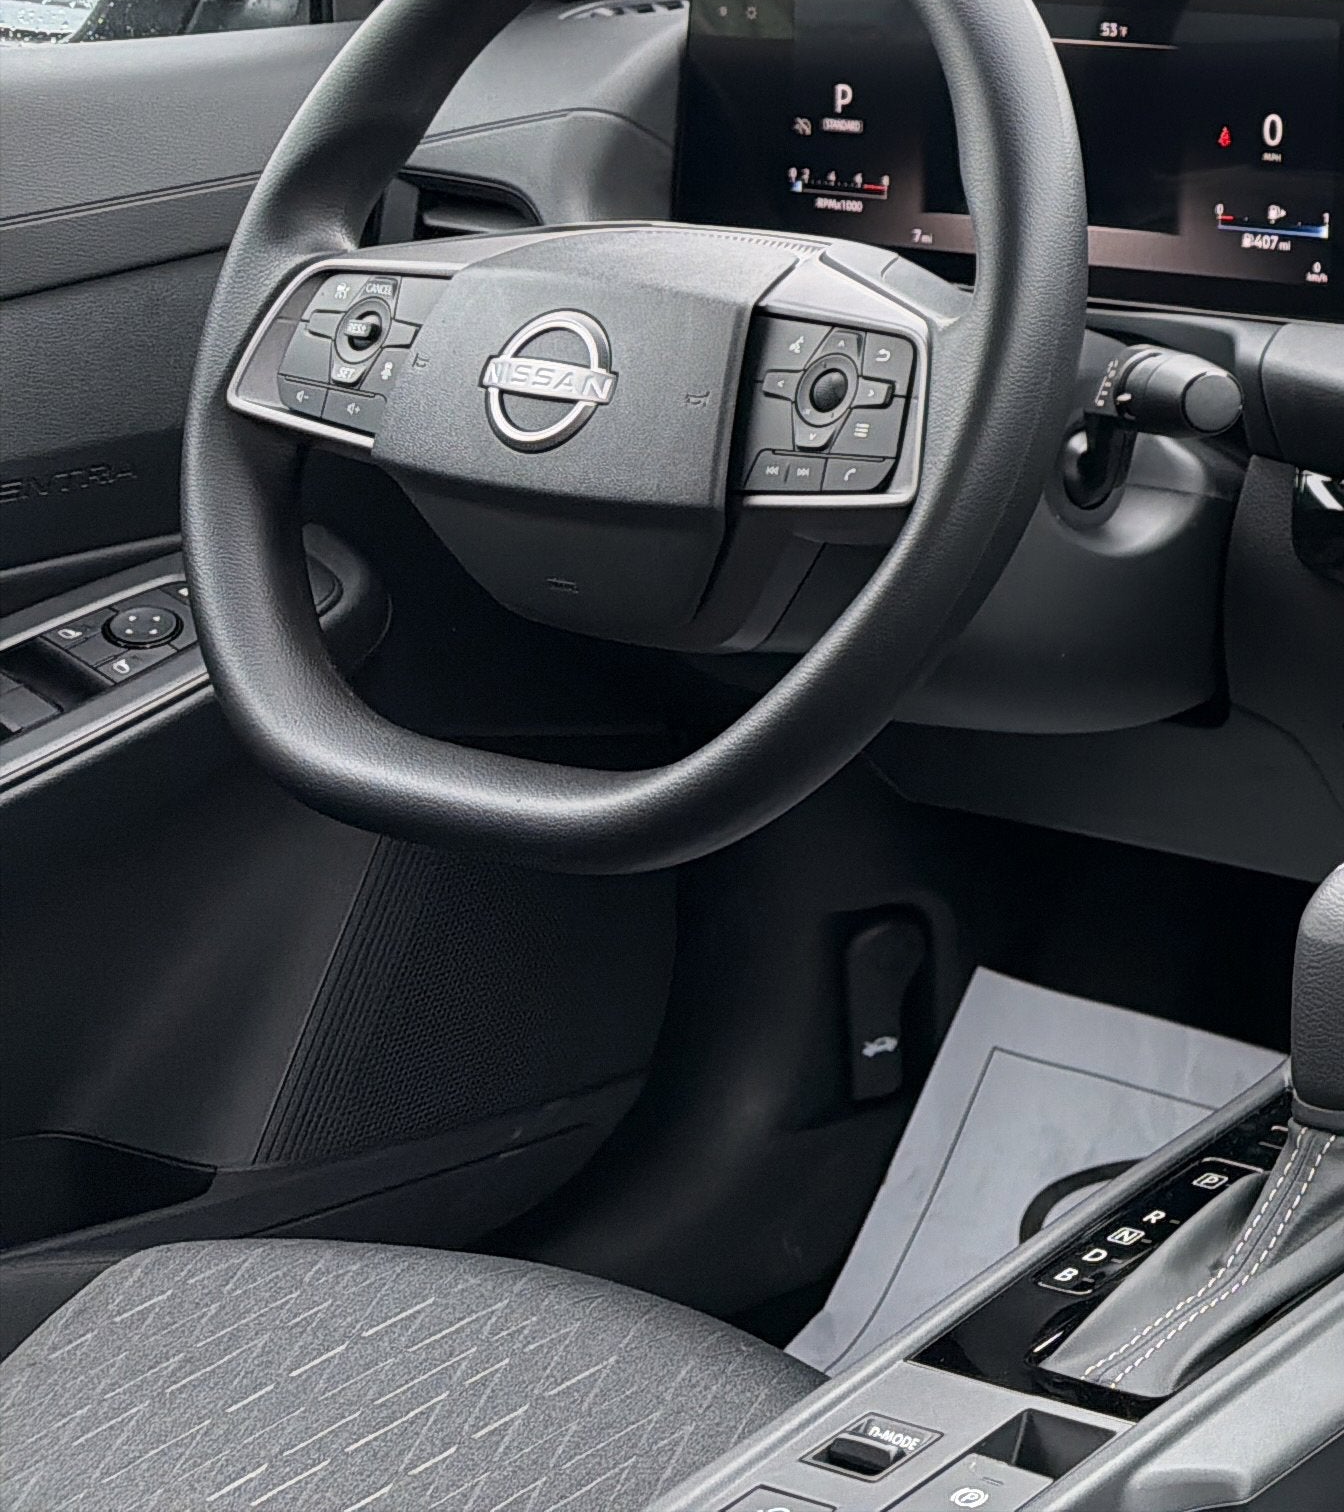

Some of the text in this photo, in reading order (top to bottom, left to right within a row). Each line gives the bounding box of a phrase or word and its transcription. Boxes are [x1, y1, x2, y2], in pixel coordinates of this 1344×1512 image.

[834, 83, 853, 113] P
[1263, 113, 1283, 147] 0
[1255, 235, 1291, 251] 407 mi
[365, 282, 392, 296] CANCEL
[483, 360, 614, 400] NISSAN
[1143, 1210, 1166, 1224] R
[1082, 1248, 1108, 1262] D
[1054, 1268, 1079, 1282] B
